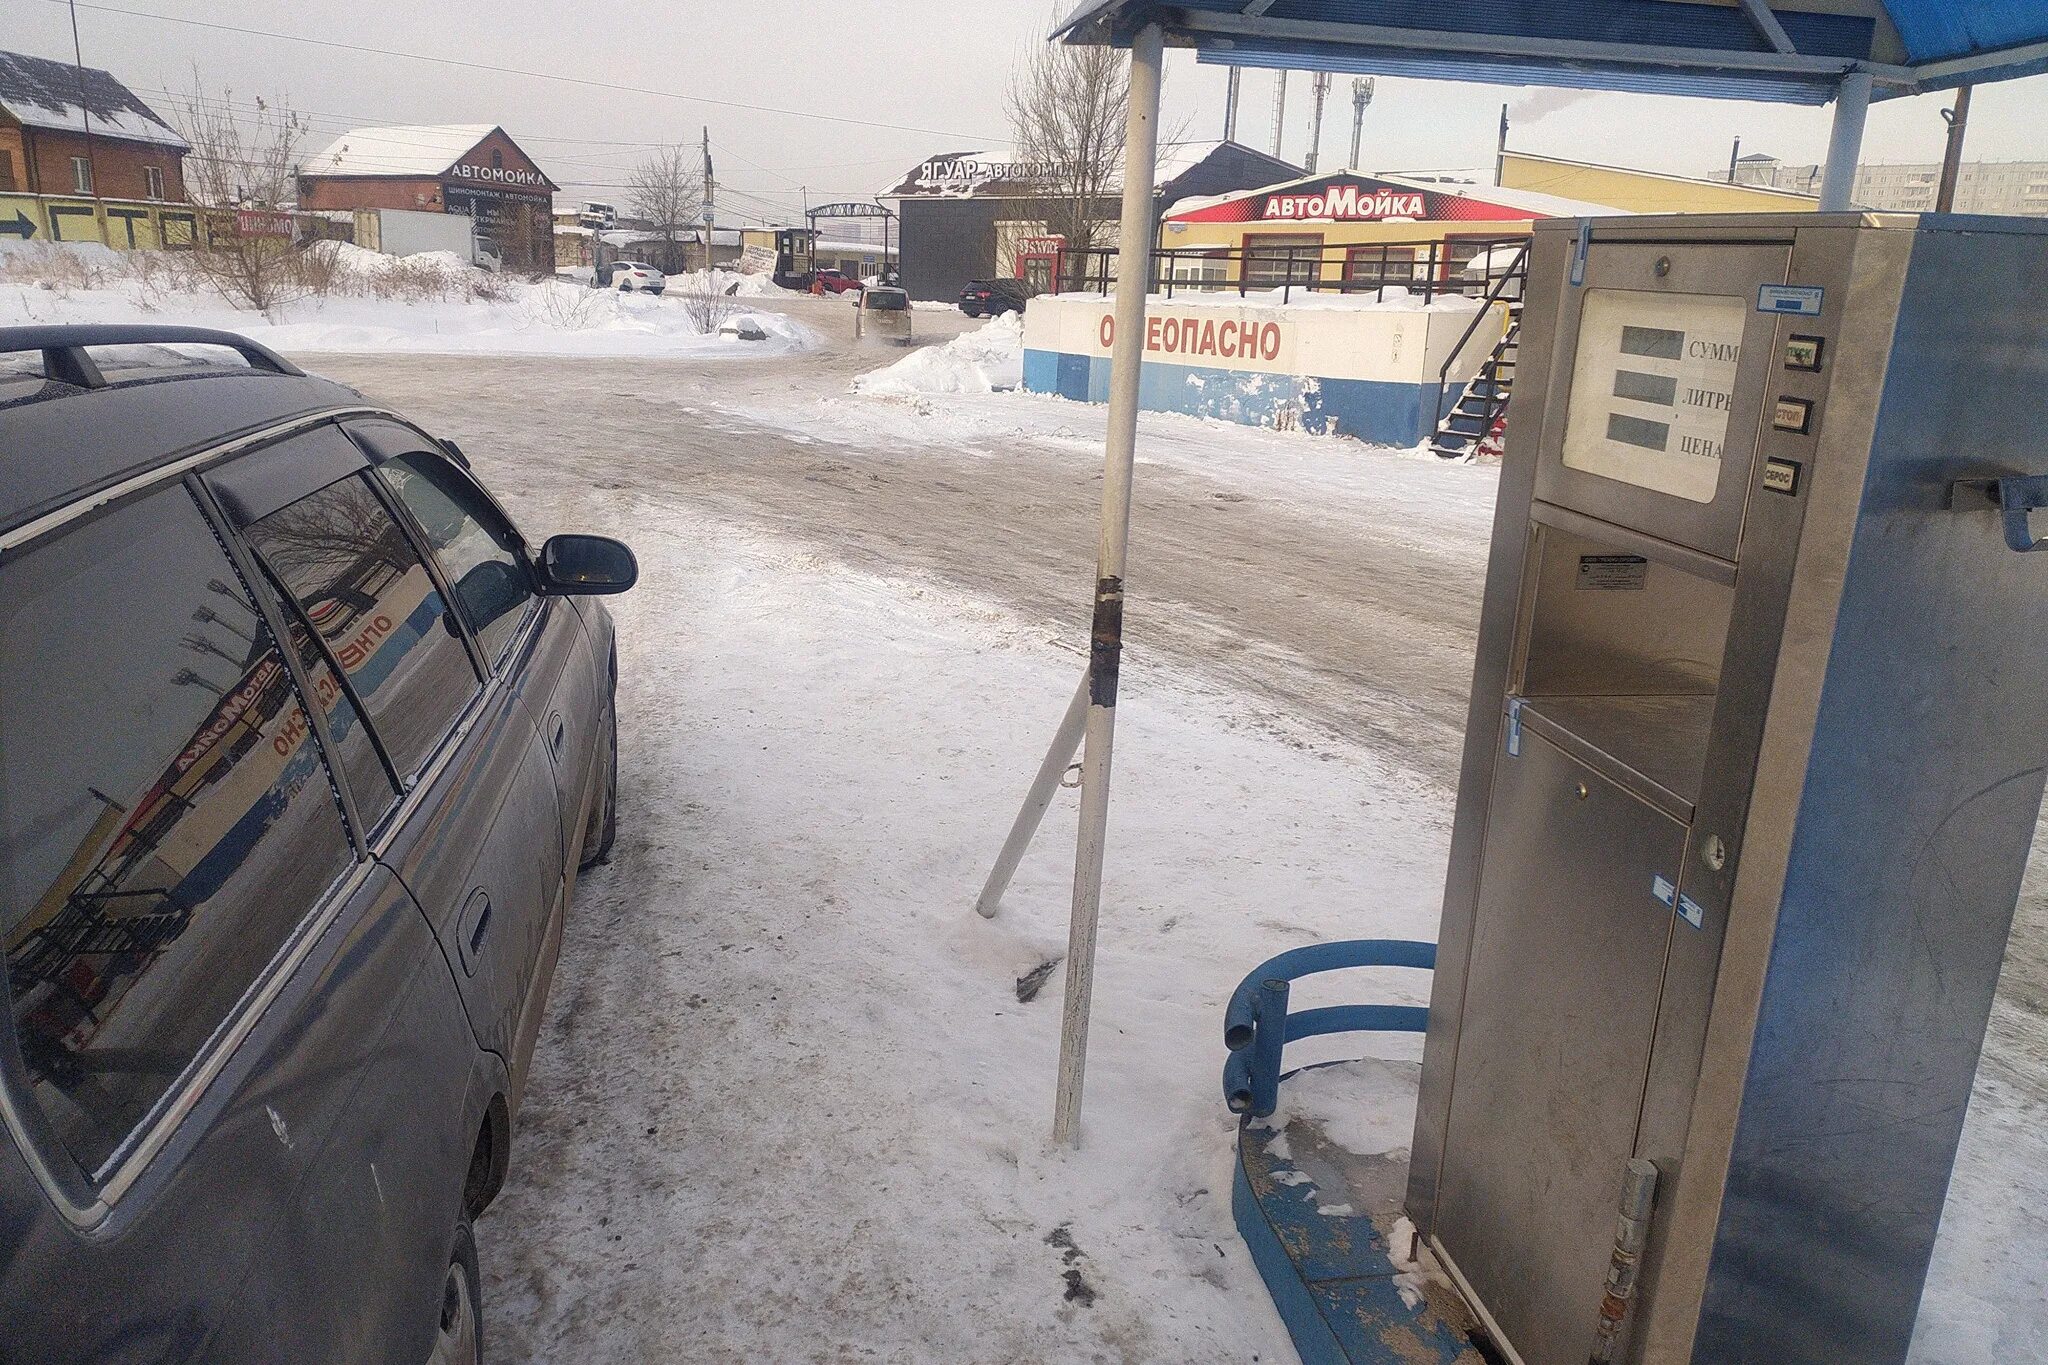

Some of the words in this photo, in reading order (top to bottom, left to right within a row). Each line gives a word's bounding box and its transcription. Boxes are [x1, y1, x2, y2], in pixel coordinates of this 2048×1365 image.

[452, 165, 546, 185] АВТОМОЙКА
[921, 160, 977, 180] ЯГУАР
[448, 187, 500, 199] ШИНОМОНТАЖ
[505, 194, 547, 203] АВТОМОЙКА
[1100, 314, 1281, 361] ОЕОПАСНО
[1689, 341, 1739, 362] СУММ
[1776, 408, 1801, 422] СТОП
[1680, 435, 1722, 459] ЦЕНА
[1765, 469, 1790, 483] СБРОС
